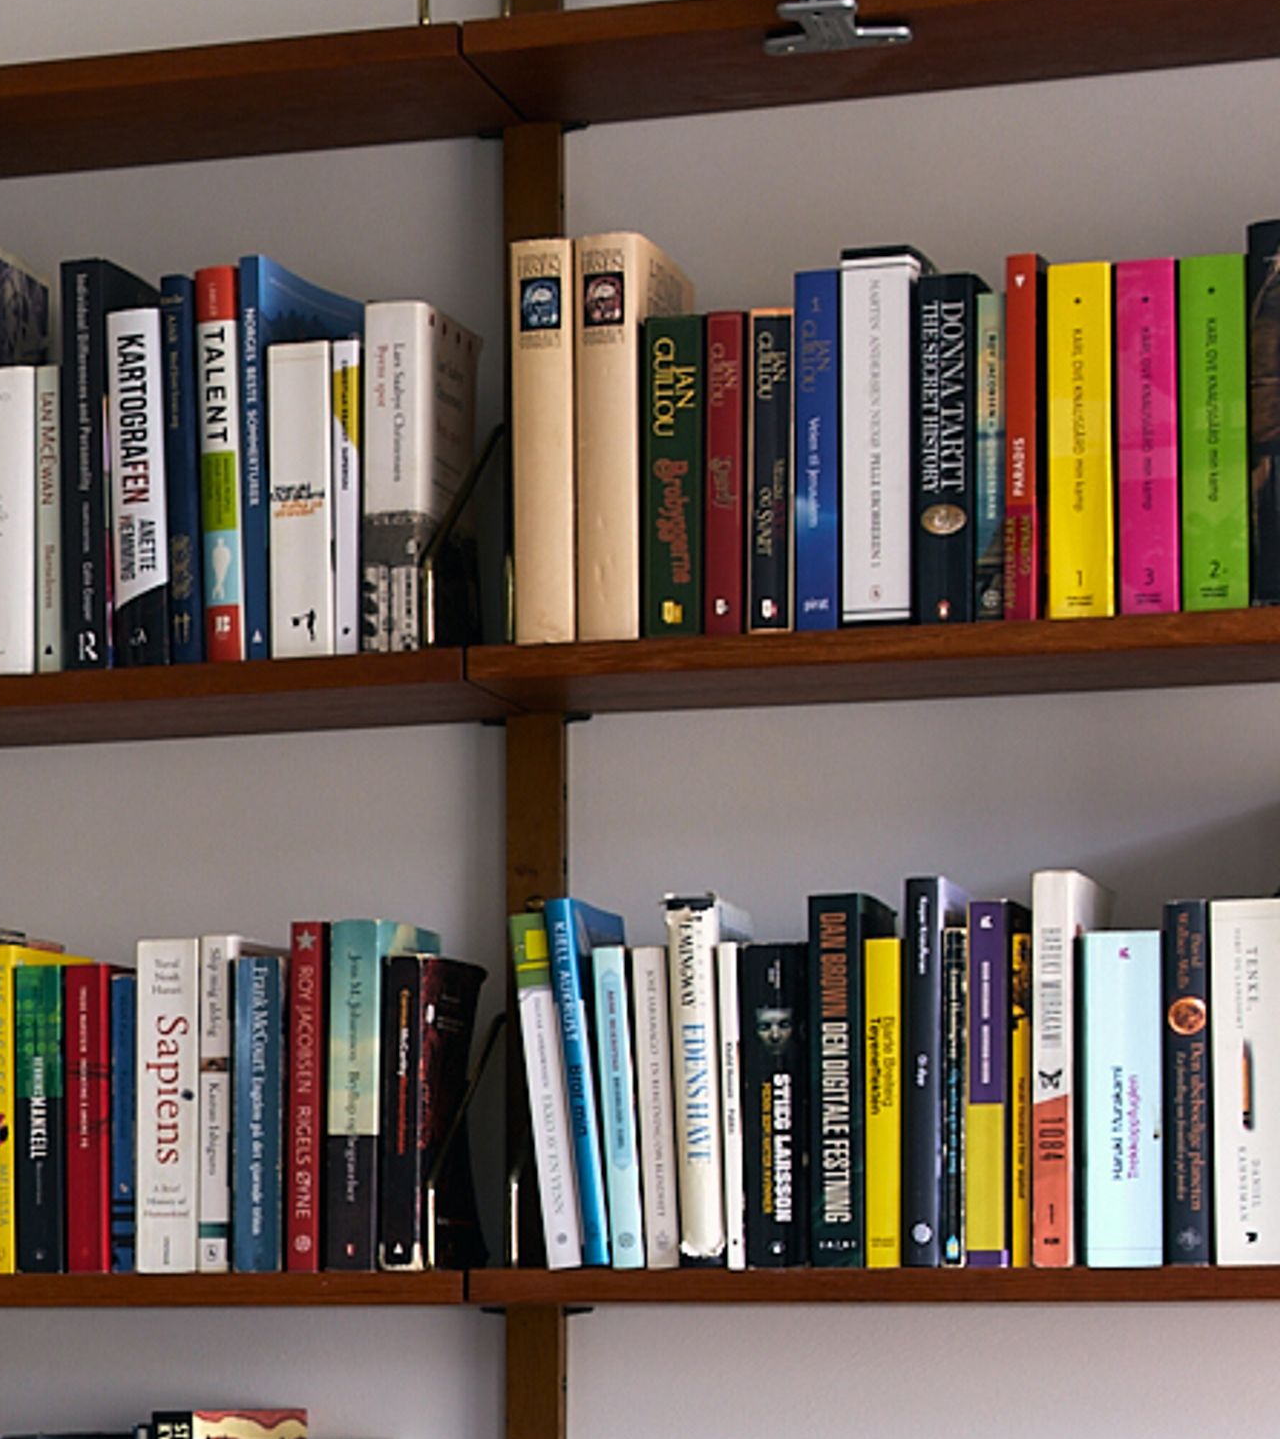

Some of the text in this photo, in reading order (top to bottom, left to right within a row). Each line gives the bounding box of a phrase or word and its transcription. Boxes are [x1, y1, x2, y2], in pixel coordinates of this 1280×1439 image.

[76, 273, 92, 492] Individual Differences and Personality
[203, 326, 229, 445] TALENT
[244, 307, 260, 507] NORGES BESTE SOMMERTURER
[652, 337, 676, 438] GUILLOU
[672, 365, 697, 409] JAN
[722, 360, 737, 389] JAN
[756, 331, 774, 400] GUILLOU
[771, 351, 787, 383] JAN
[816, 339, 832, 372] JAN
[921, 300, 939, 494] THE SECRET HISTORY
[938, 300, 966, 492] DONNA TARTT
[116, 334, 150, 506] KARTOGRAFEN
[807, 416, 821, 451] Veien
[1012, 437, 1025, 497] PARADIS
[1071, 329, 1087, 512] KARL OVE KNAUSGÅRD min kamp
[138, 519, 157, 572] ANETTE
[652, 457, 692, 583] Brobyggerne
[806, 468, 821, 529] Jerusalem
[1039, 927, 1062, 1050] HARUKI MURAKAMI
[1189, 933, 1202, 968] David
[145, 1015, 190, 1165] Sapiens
[553, 920, 589, 1139] KJELL AUKRUST Bror min
[819, 911, 851, 1223] DAN BROWN DEN DIGITALE FESTNING
[296, 965, 313, 1219] ROY JACOBSEN RIGELS ØYNE
[682, 1023, 710, 1165] EDENS HAVE
[772, 1073, 791, 1223] STIEG LARSSON
[1110, 1065, 1123, 1181] Haruki Murakami
[1189, 1042, 1205, 1211] Den ubeboelige planeten
